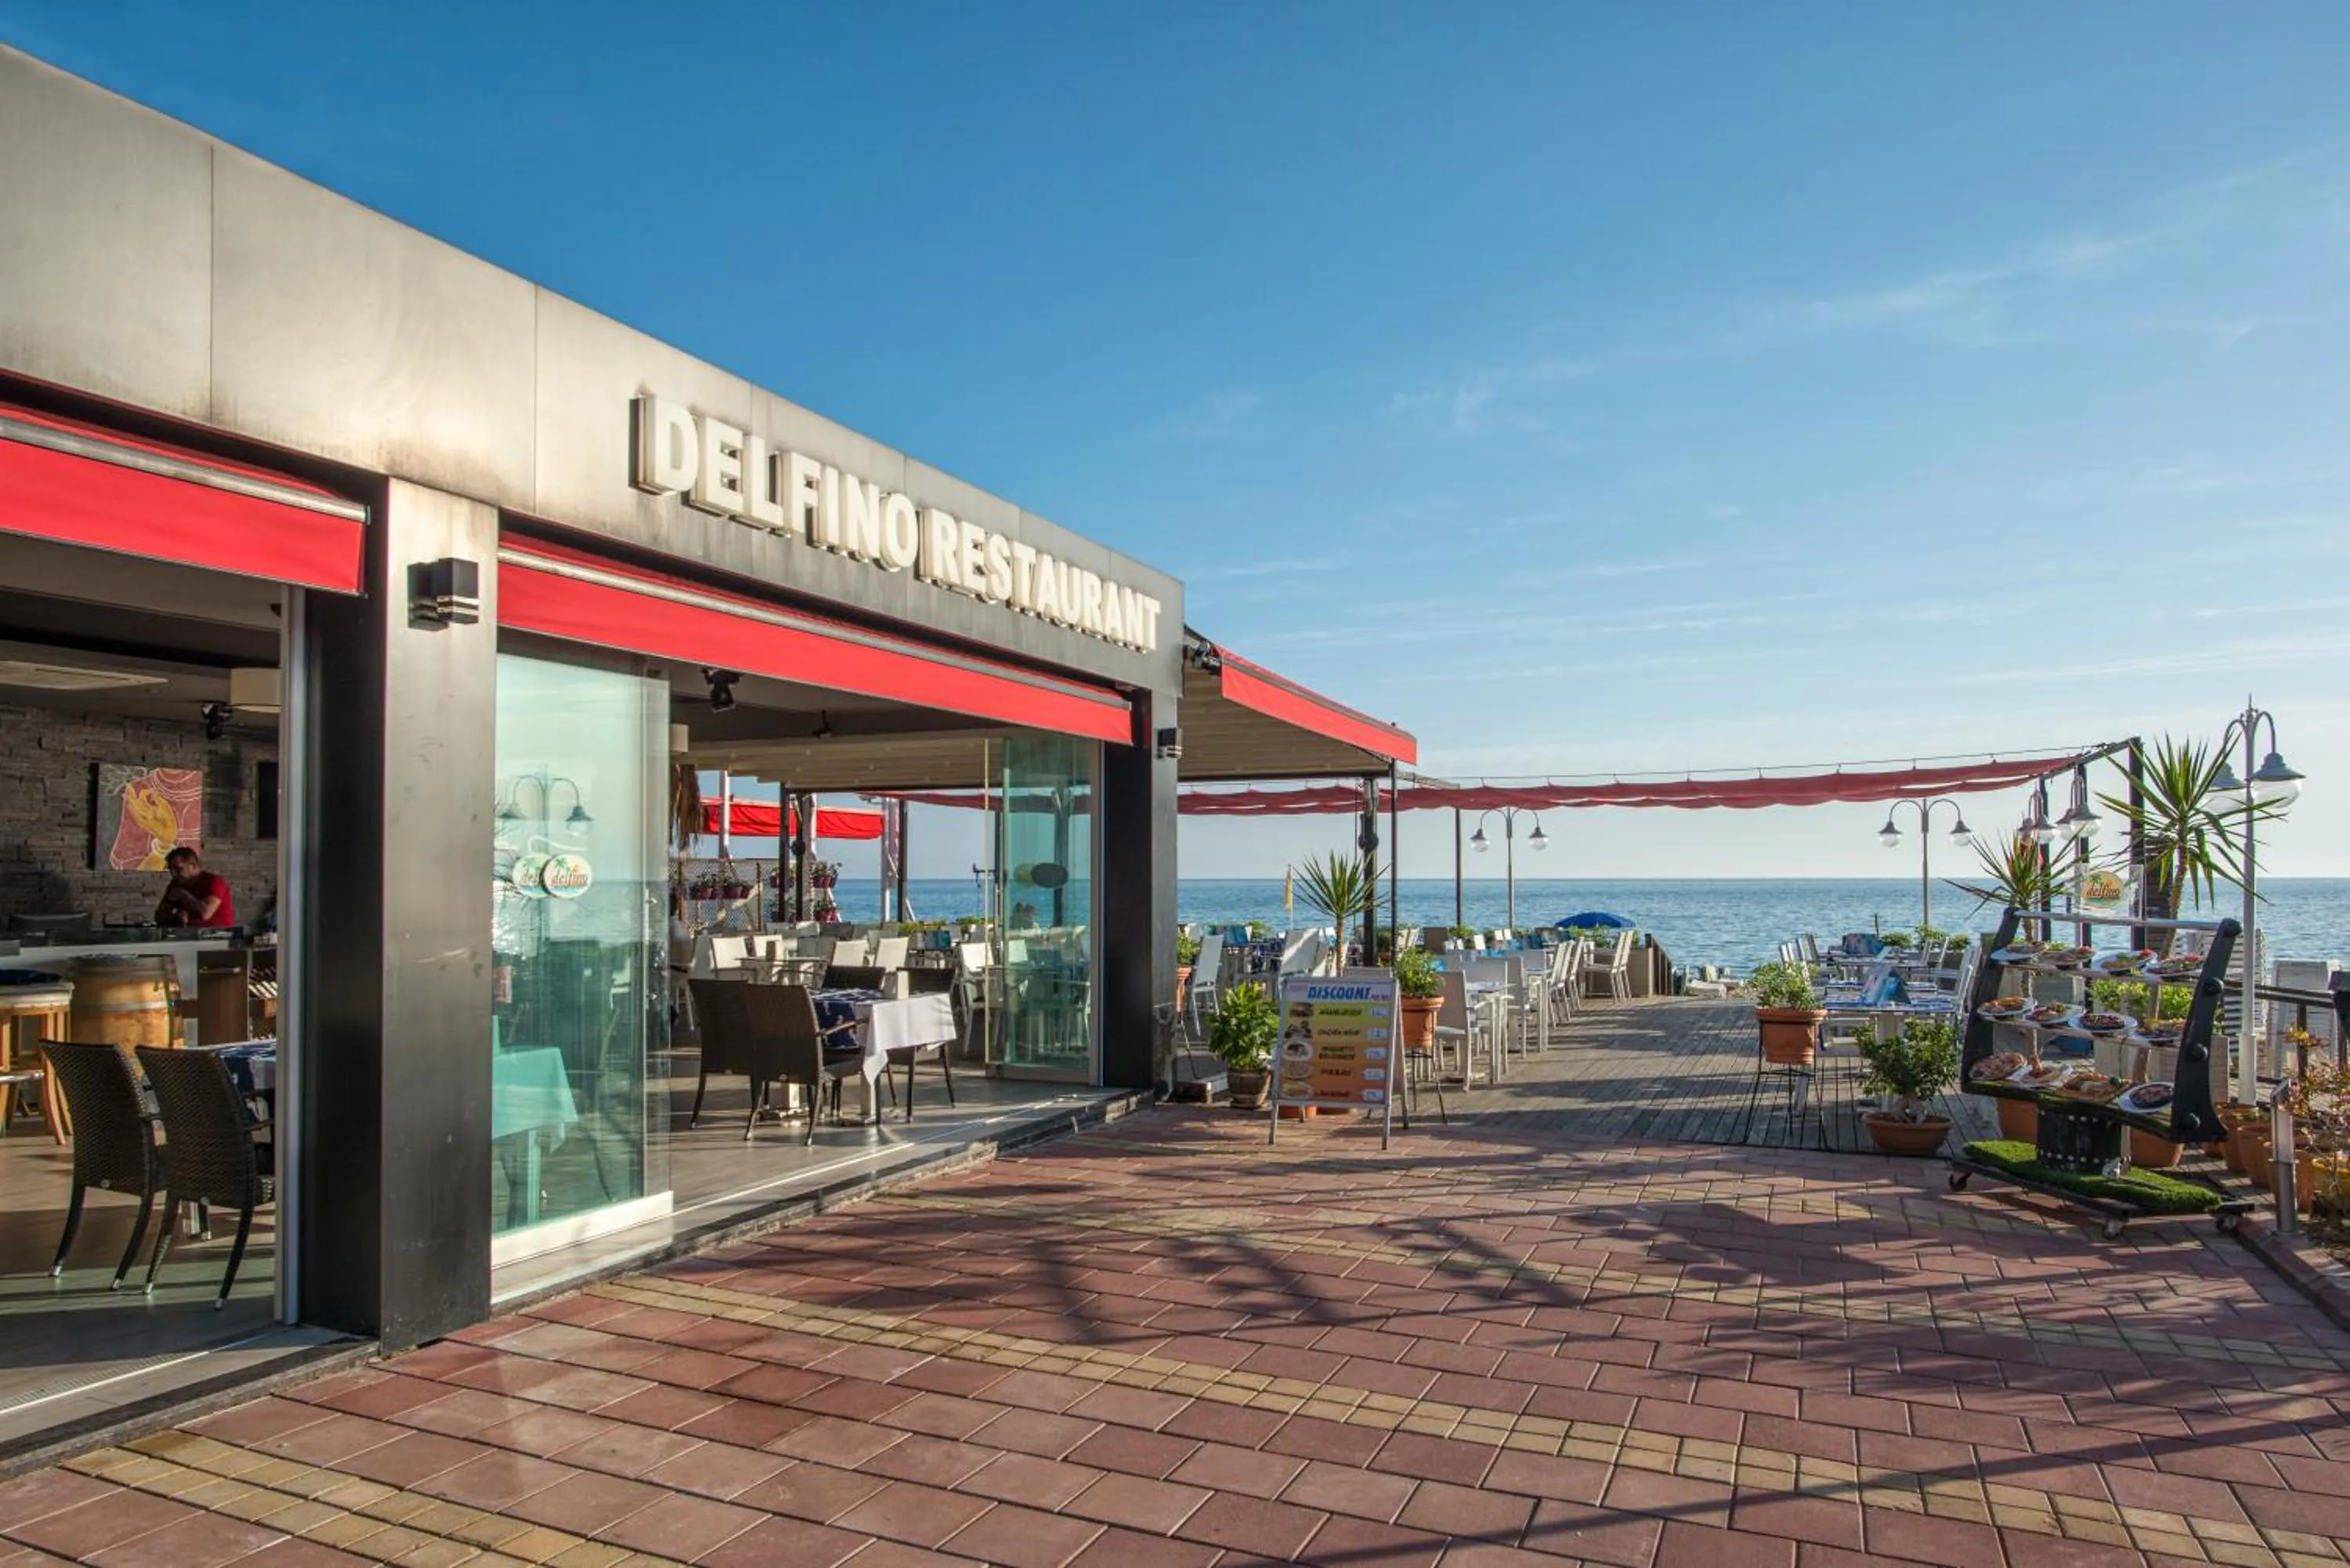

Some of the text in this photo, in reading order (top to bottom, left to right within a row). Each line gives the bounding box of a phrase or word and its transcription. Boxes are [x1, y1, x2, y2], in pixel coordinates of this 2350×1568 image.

[628, 393, 1162, 652] DELFINO RESTAURANT
[1307, 985, 1372, 1000] DISCOUNT
